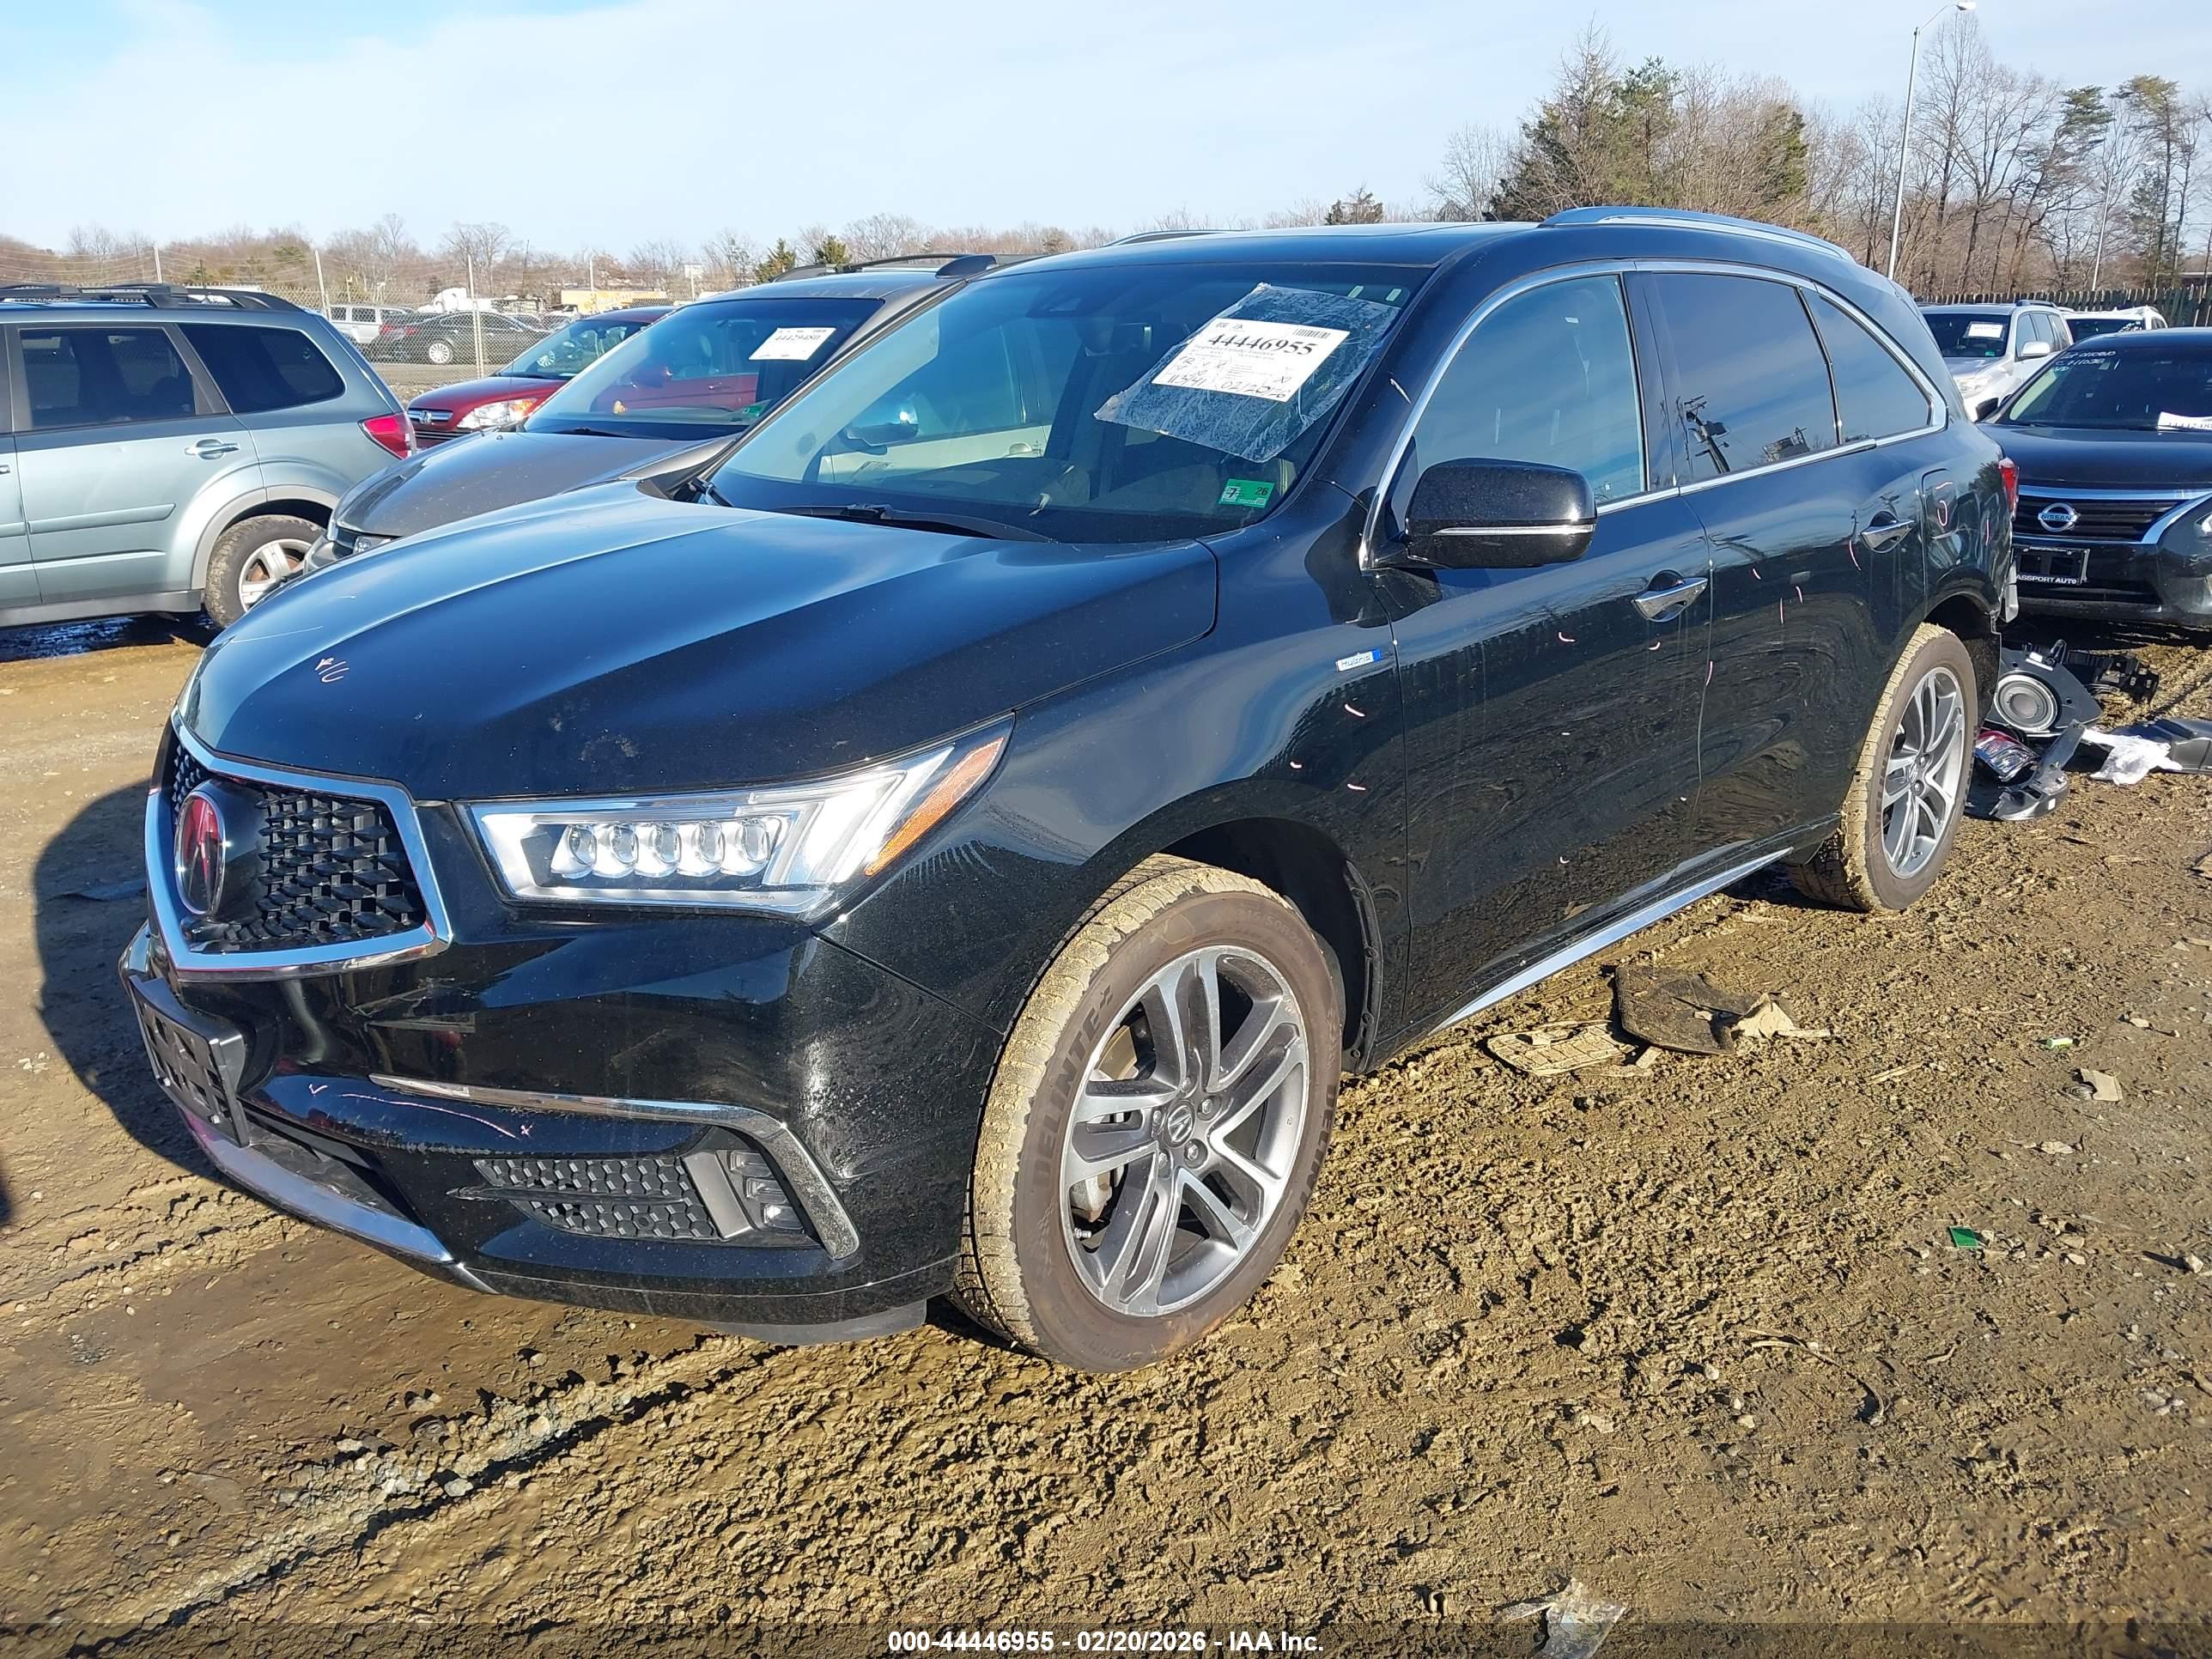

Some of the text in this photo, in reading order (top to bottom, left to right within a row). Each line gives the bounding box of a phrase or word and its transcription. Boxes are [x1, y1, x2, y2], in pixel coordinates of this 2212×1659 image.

[1208, 333, 1319, 355] 44446955
[2015, 574, 2055, 583] ASSPORT
[1033, 1006, 1101, 1188] DELINTE
